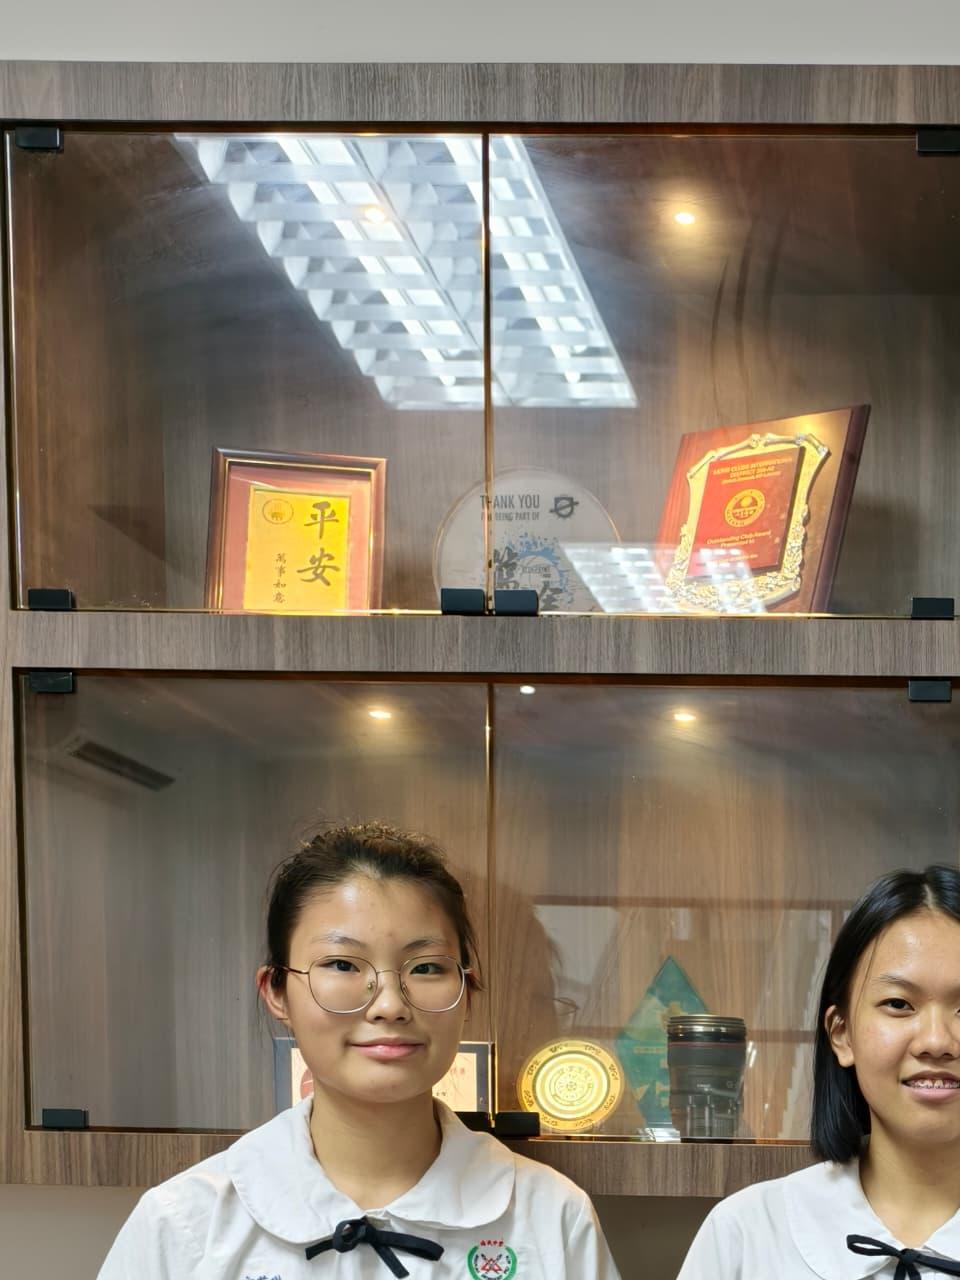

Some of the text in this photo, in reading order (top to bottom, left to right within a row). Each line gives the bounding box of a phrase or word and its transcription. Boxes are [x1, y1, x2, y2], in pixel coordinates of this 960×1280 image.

[517, 494, 540, 509] YOU
[297, 501, 341, 587] 平安
[273, 552, 287, 603] 萬事如意
